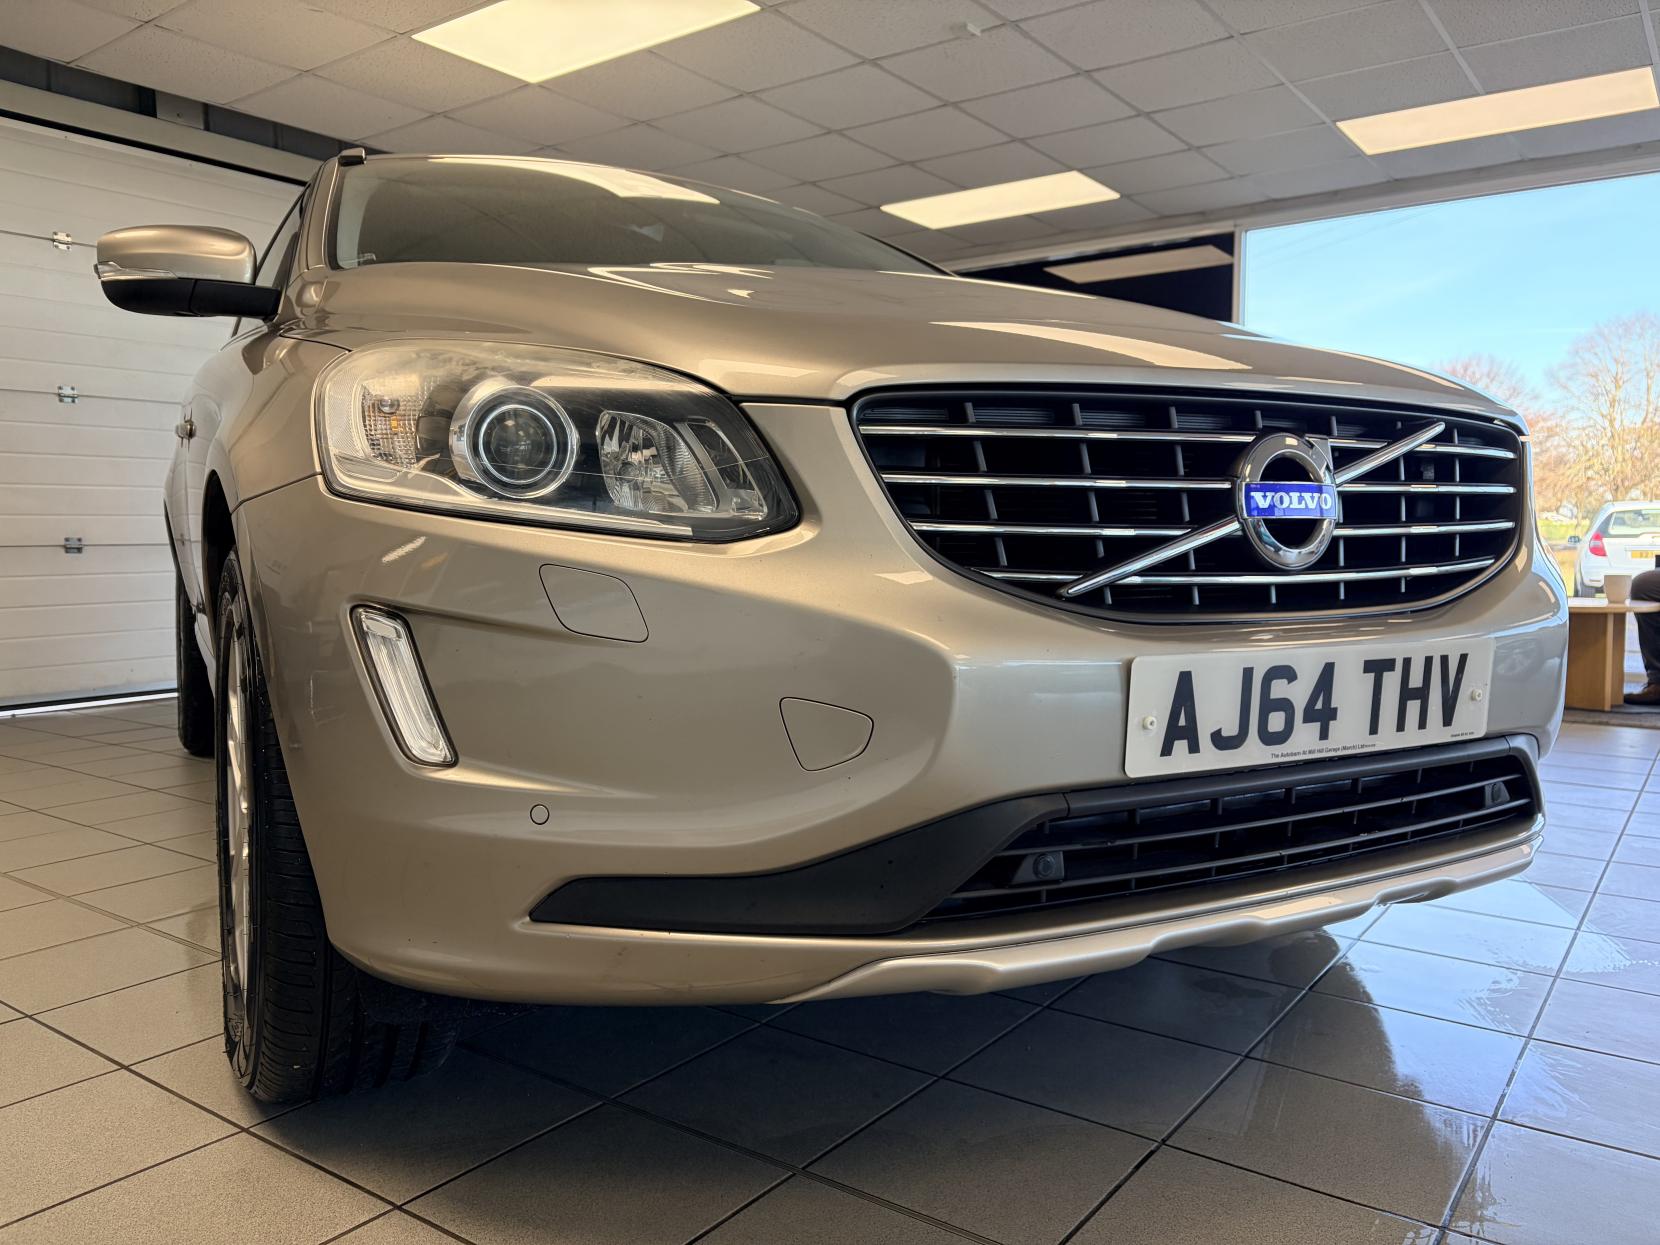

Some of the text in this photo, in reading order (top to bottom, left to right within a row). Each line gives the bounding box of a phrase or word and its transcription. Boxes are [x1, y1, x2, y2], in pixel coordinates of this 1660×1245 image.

[1250, 491, 1332, 510] VOLVO
[1160, 652, 1469, 758] AJ64 THV
[1341, 743, 1358, 751] (March)
